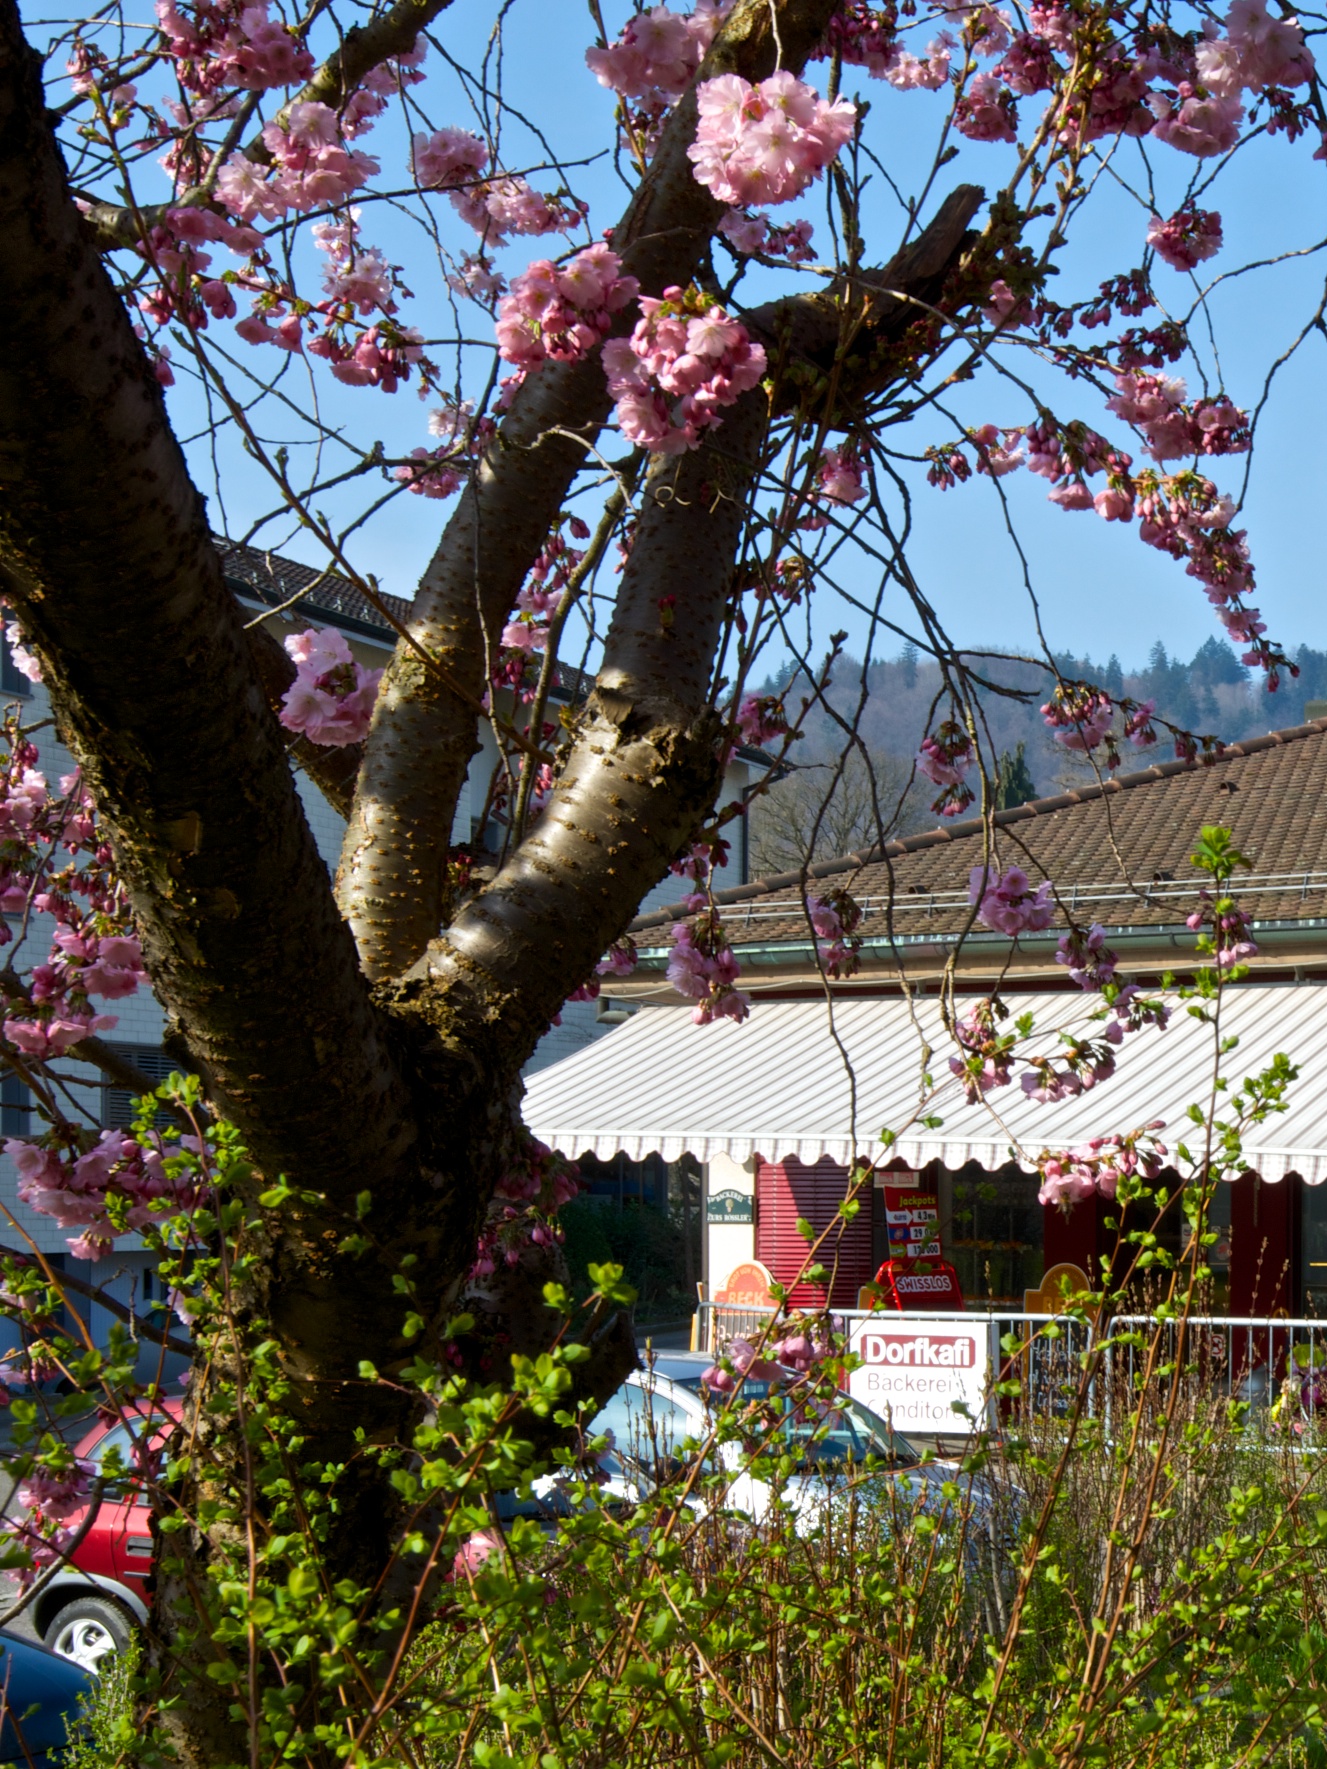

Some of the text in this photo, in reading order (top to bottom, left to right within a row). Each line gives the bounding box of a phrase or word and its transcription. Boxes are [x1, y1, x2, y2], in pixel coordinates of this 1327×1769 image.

[899, 1195, 936, 1208] Jackpots
[897, 1275, 951, 1292] SWISSLOS
[728, 1291, 765, 1306] BECK
[866, 1336, 970, 1366] Dorfkafi
